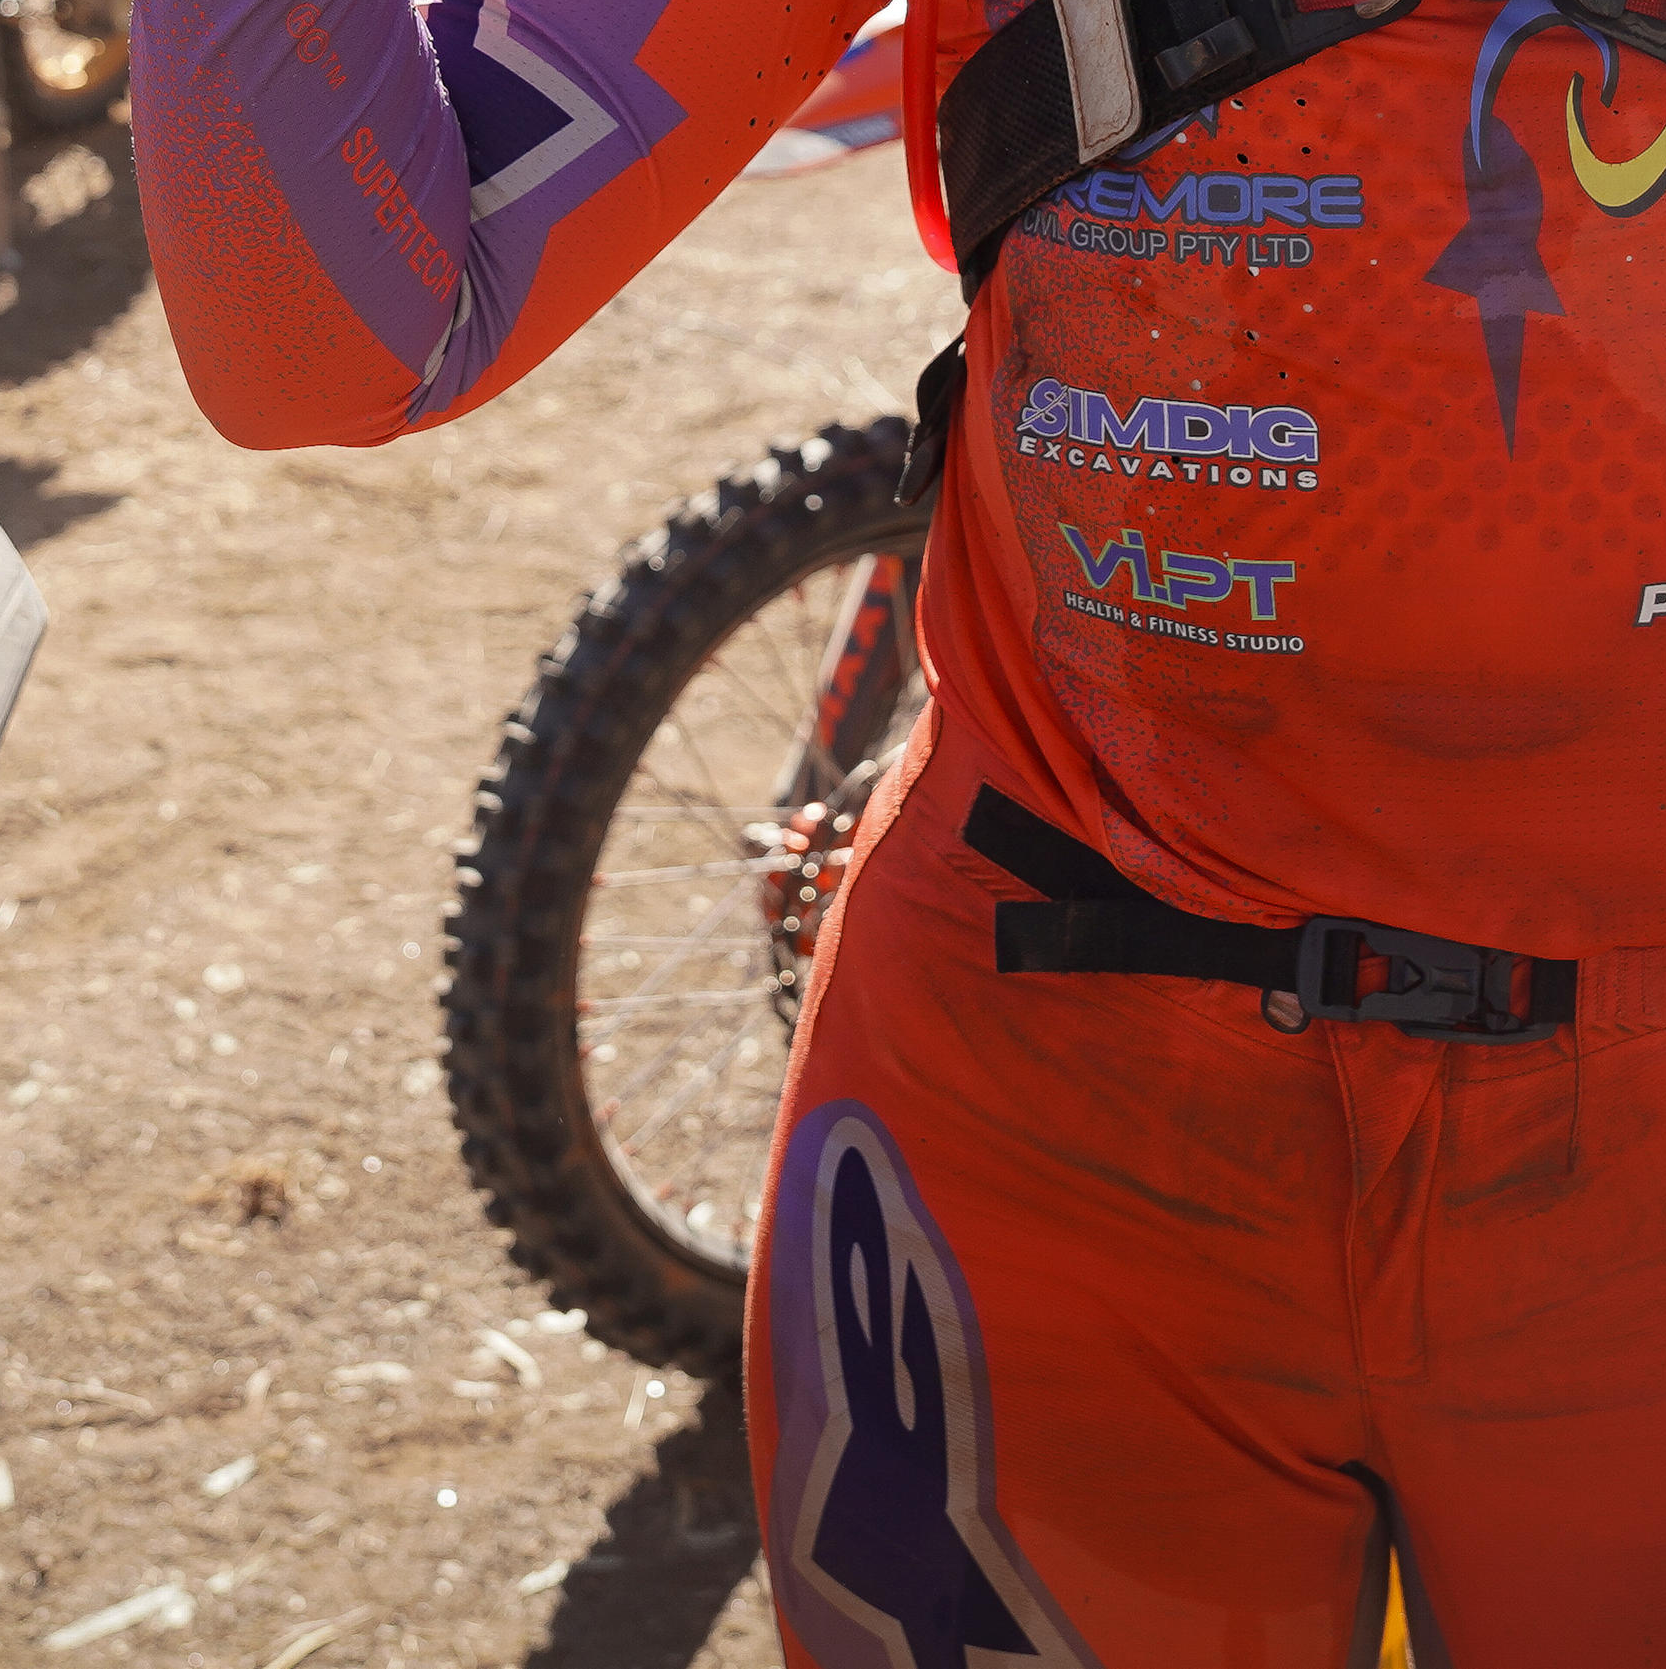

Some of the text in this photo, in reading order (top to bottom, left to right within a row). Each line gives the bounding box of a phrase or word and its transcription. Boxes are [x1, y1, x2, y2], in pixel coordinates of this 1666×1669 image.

[342, 126, 459, 303] SUPERTECH
[1054, 171, 1362, 224] REMORE
[1071, 221, 1168, 257] GROUP
[1179, 234, 1240, 264] PTY
[1251, 235, 1313, 264] LTD
[1017, 378, 1319, 463] SIMDIG
[1019, 436, 1319, 488] EXCAVATIONS
[1065, 593, 1305, 652] HEALTH & FITNESS STUDIO
